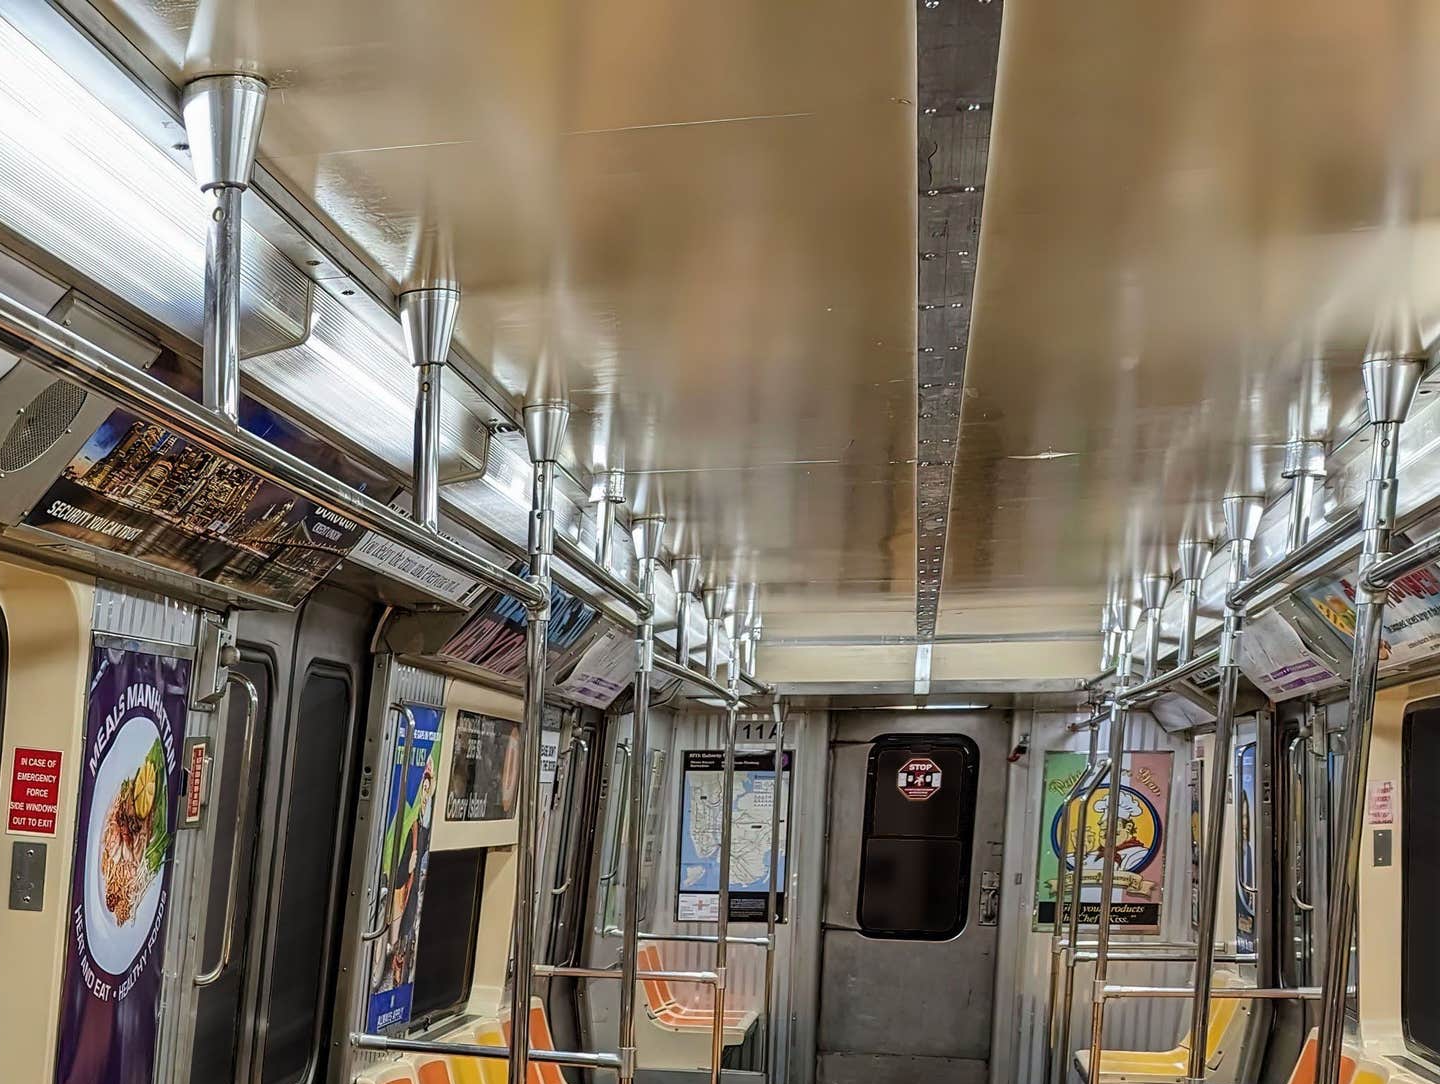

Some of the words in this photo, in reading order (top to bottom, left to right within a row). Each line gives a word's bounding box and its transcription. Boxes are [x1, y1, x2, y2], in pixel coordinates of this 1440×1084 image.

[46, 500, 95, 527] SECURITY
[86, 515, 110, 533] YOU
[89, 693, 126, 778] MEALS
[126, 683, 177, 776] MANHATTAN
[21, 757, 28, 766] IN
[28, 758, 47, 768] CASE
[47, 759, 57, 768] OF
[909, 763, 933, 771] STOP
[17, 772, 57, 784] EMERGENCY
[26, 787, 49, 798] FORCE
[10, 801, 25, 811] SIDE
[26, 802, 57, 814] WINDOWS
[12, 816, 27, 825] OUT
[28, 817, 37, 827] TO
[37, 818, 53, 829] EXIT
[74, 904, 86, 956] HEAT
[80, 955, 96, 989] AND
[93, 978, 112, 1002] EAT
[118, 949, 148, 1001] HEALTHY
